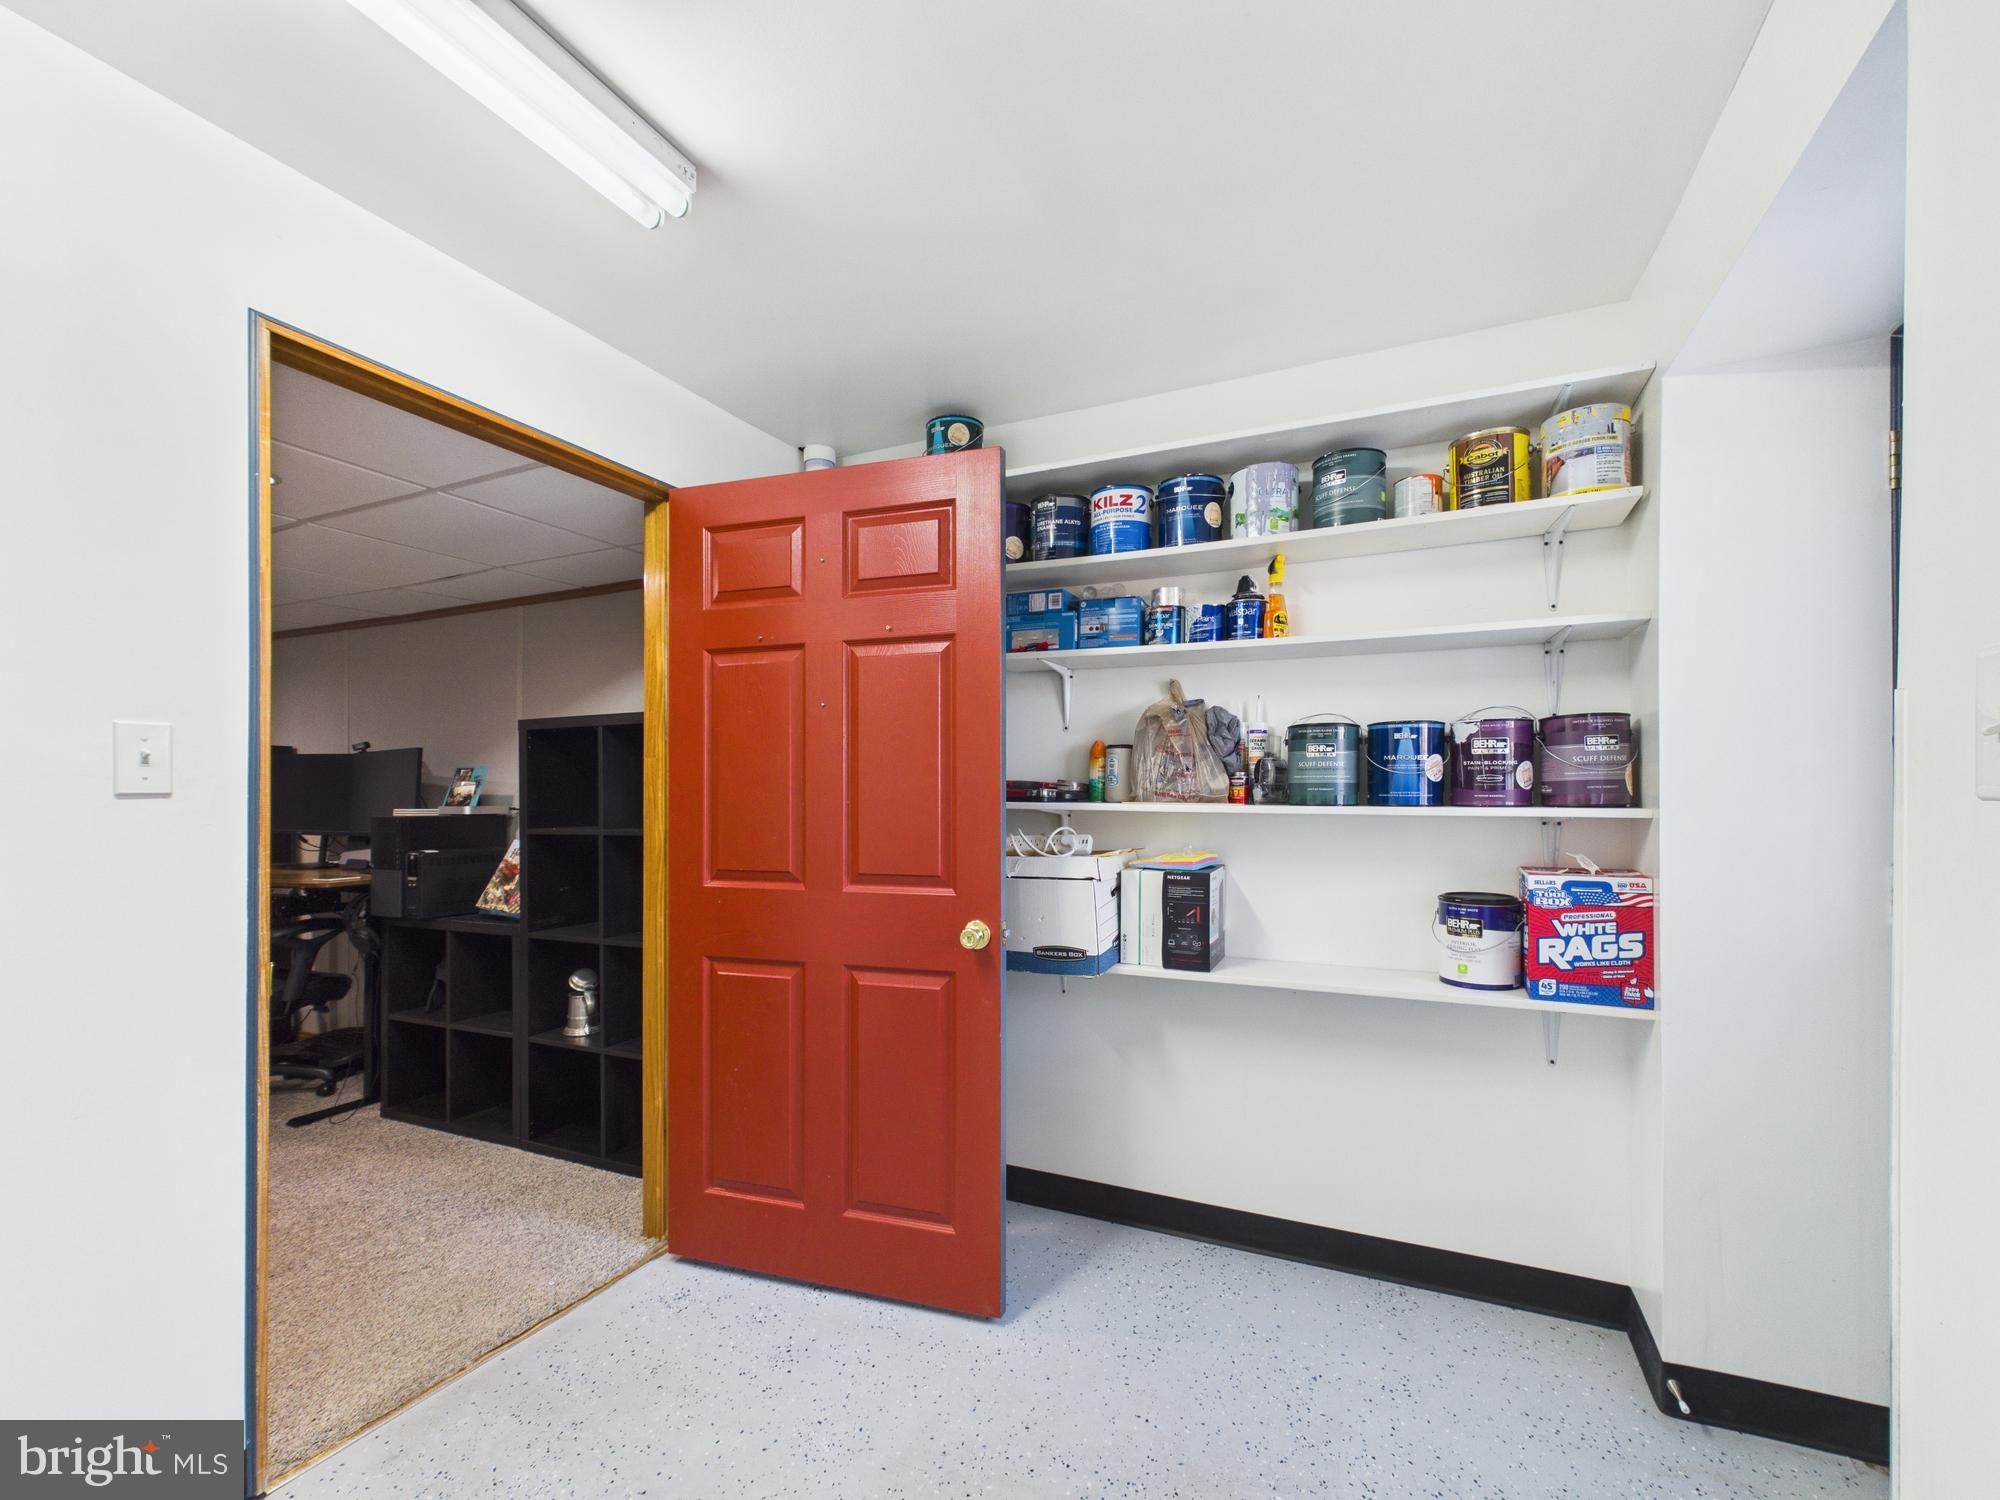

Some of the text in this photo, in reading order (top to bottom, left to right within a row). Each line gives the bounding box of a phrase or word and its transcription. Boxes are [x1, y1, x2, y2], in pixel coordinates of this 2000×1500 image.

[1466, 450, 1499, 463] Cabot
[1463, 466, 1505, 480] AUSTRALIAN
[1464, 474, 1490, 484] TIMBER
[1328, 485, 1357, 496] DEFENSE
[1093, 494, 1147, 514] KILZ 2
[1166, 504, 1204, 514] MARQUEE
[1093, 507, 1133, 518] ALL-PURPOSE
[1036, 519, 1064, 527] URETHANE
[1473, 740, 1497, 748] BEHR
[1587, 737, 1609, 745] BEHR
[1535, 890, 1567, 898] TOOL
[1535, 897, 1571, 907] BOX
[1447, 918, 1469, 929] BEHR
[1552, 919, 1617, 937] WHITE
[1538, 933, 1644, 970] RAGS
